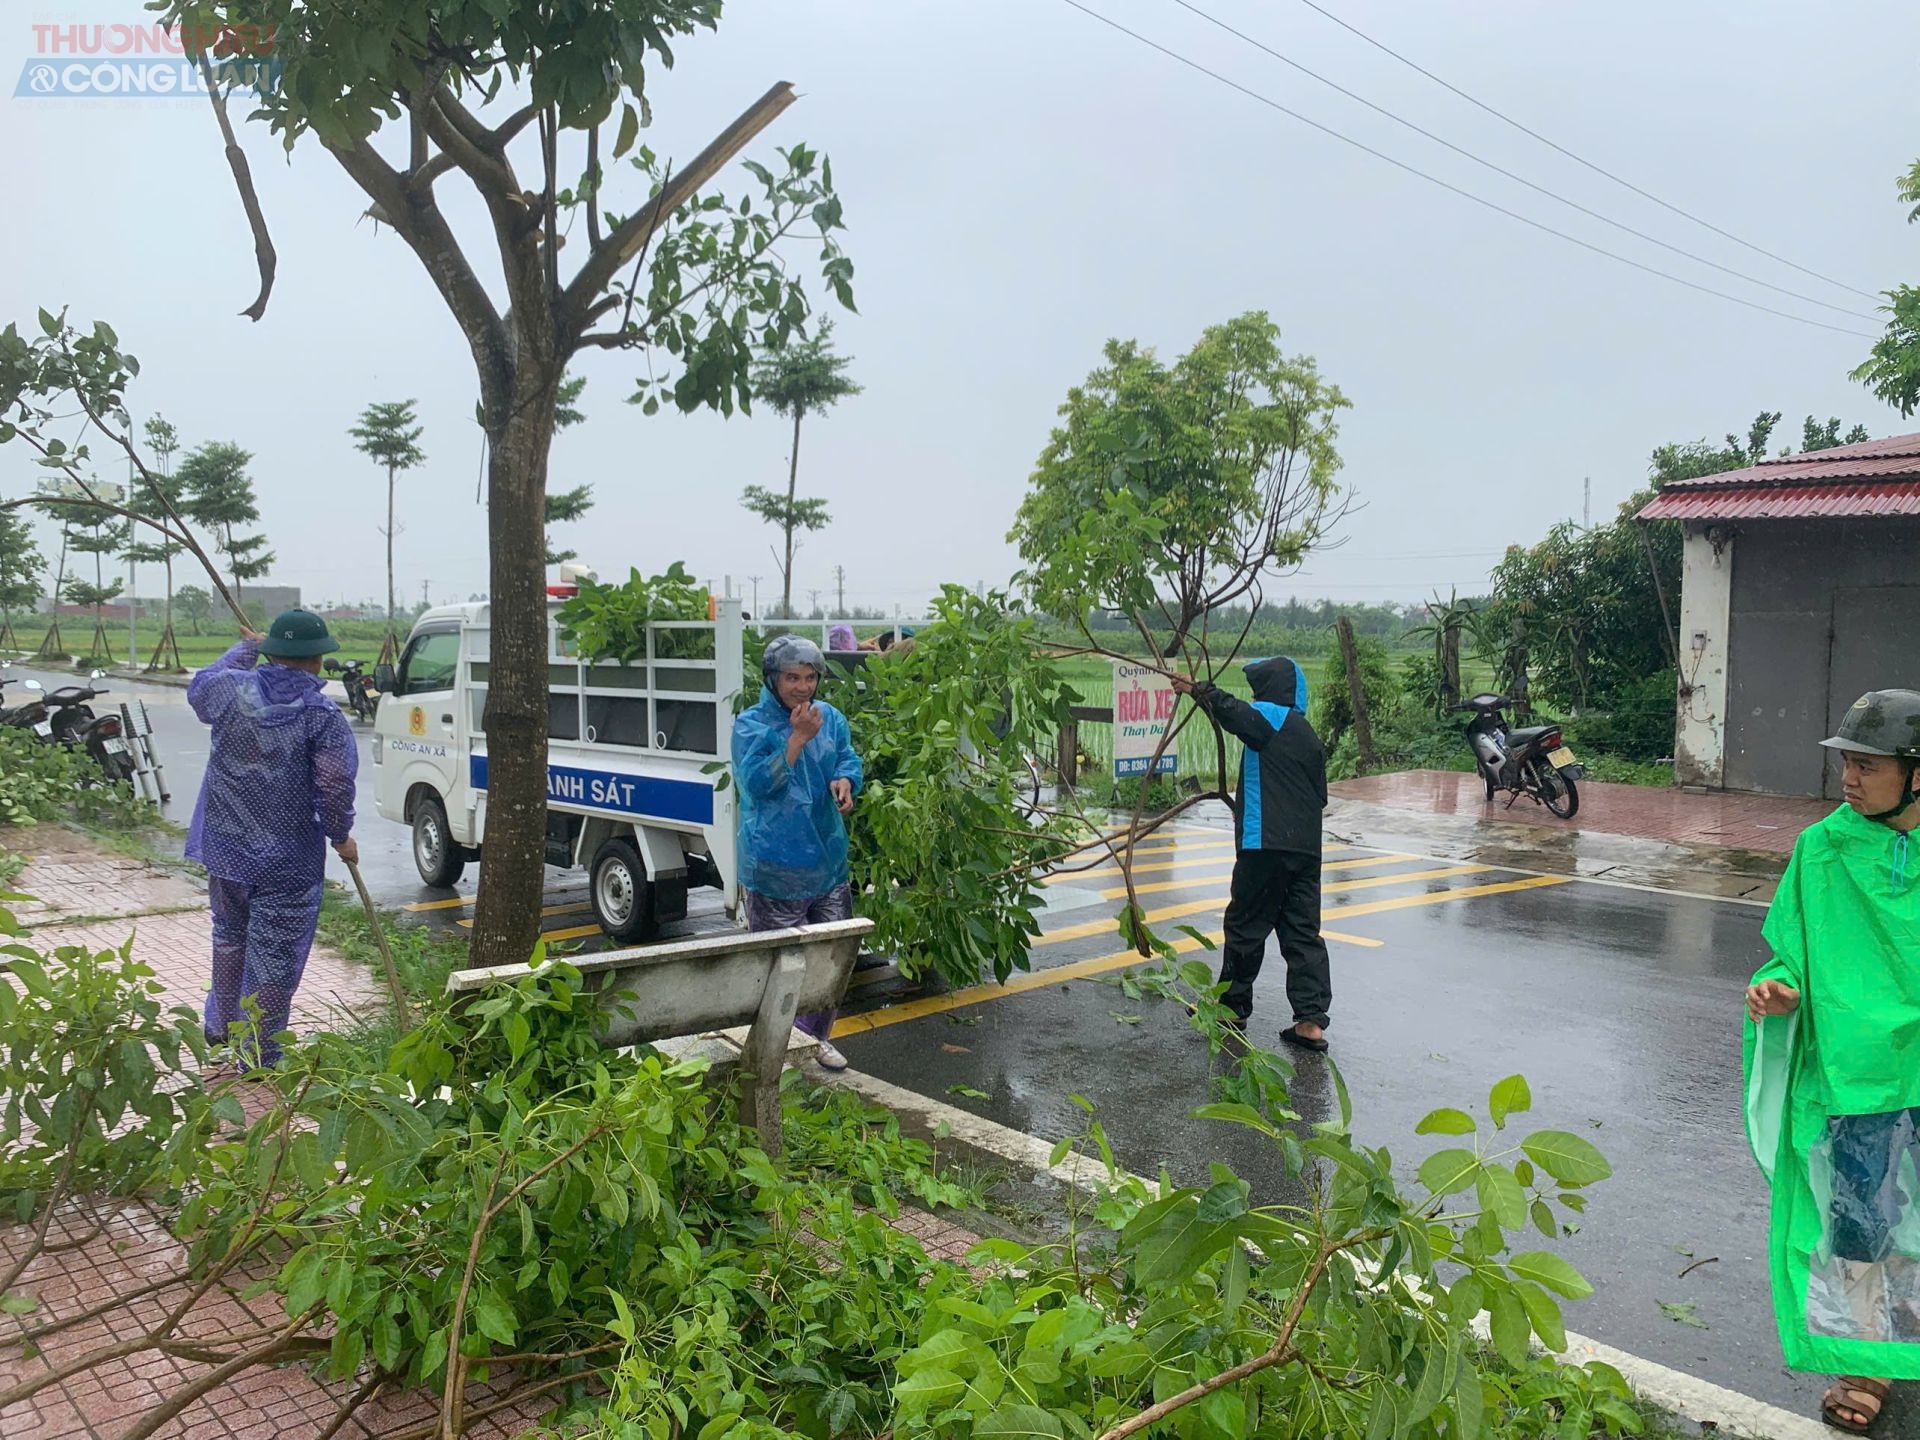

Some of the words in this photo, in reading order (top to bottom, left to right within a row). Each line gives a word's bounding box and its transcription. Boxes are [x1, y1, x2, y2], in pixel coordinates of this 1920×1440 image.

[1153, 688, 1174, 720] XE
[1123, 725, 1147, 738] Thay
[418, 744, 431, 755] AN
[591, 776, 635, 807] SÁT
